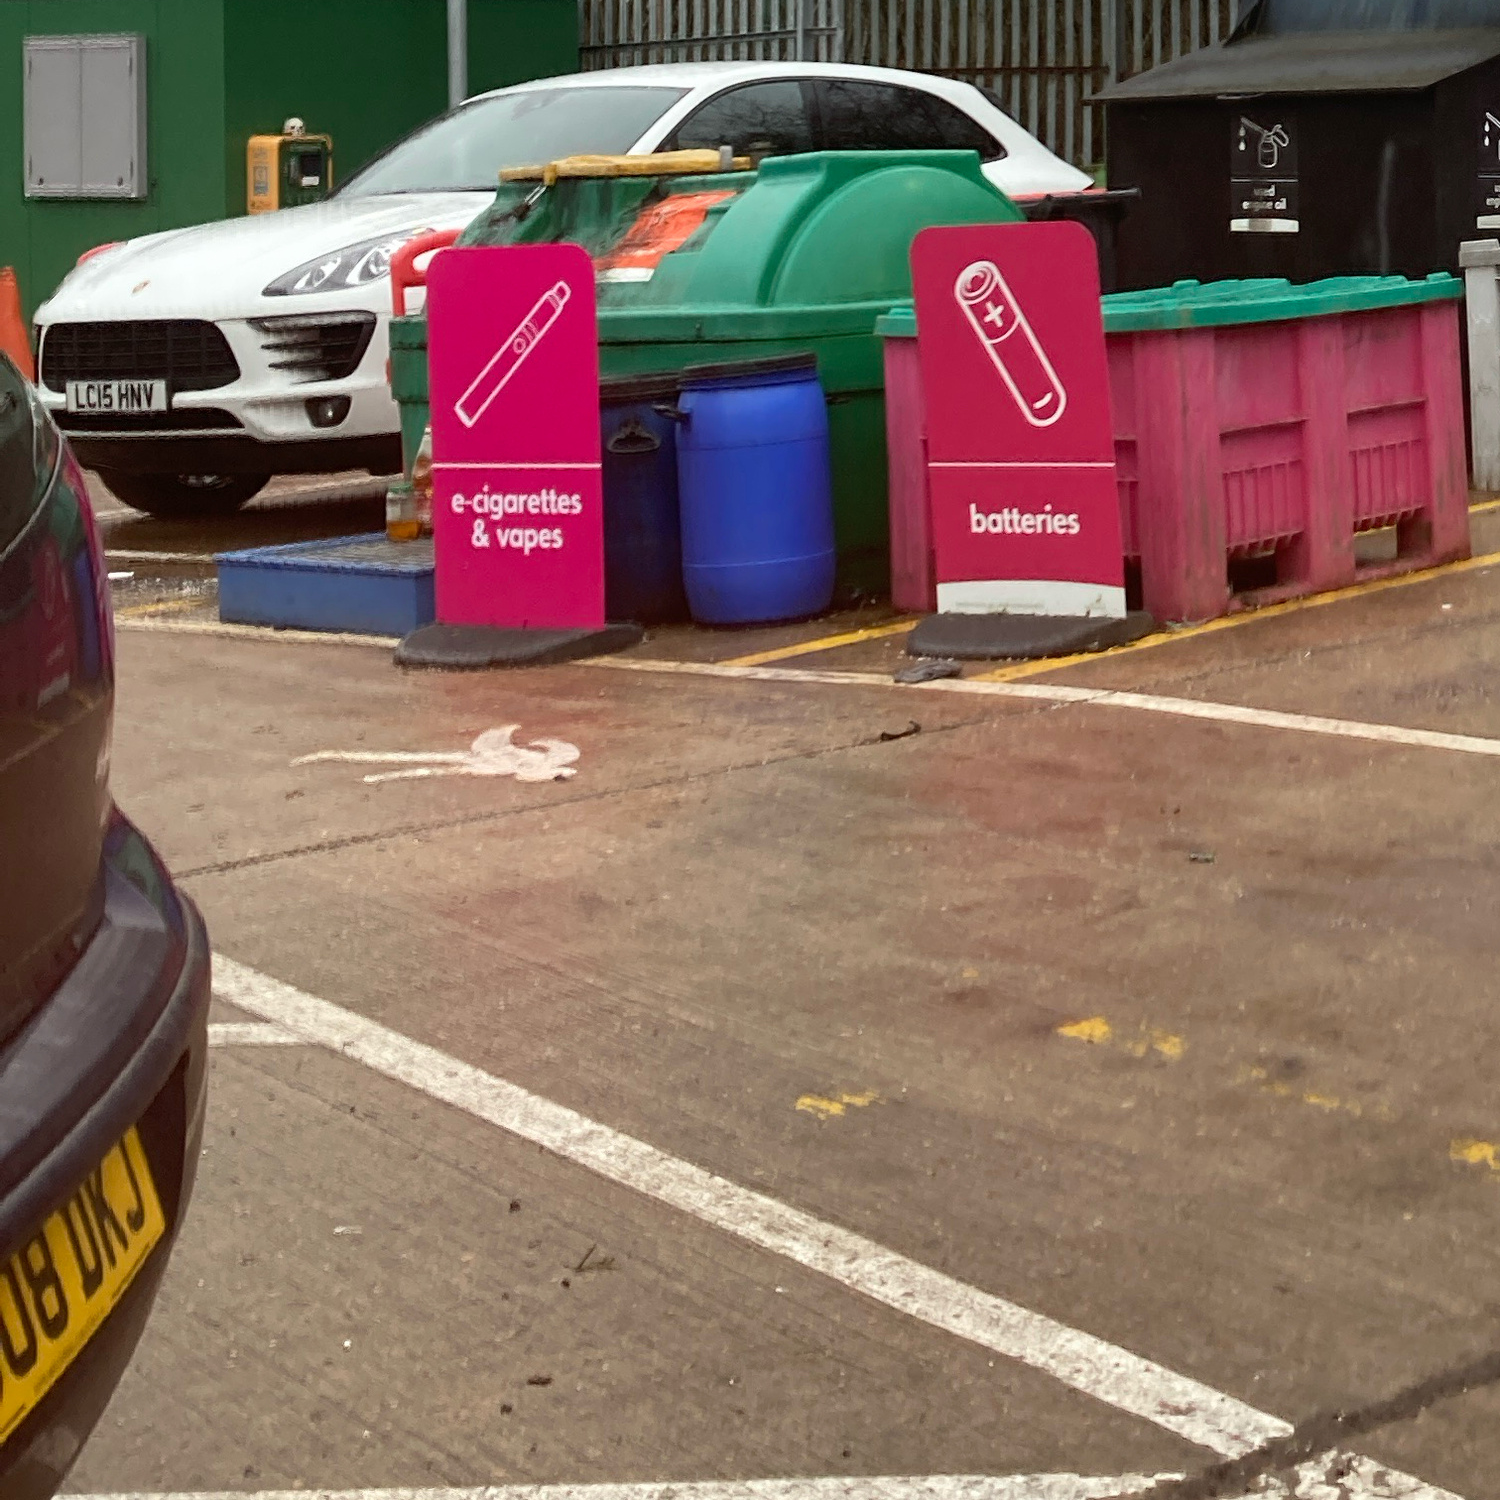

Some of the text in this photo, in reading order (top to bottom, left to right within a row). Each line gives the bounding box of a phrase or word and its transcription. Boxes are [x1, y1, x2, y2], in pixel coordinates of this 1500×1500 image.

[75, 383, 154, 409] LC15 HNV
[451, 484, 583, 521] e-cigarettes
[969, 502, 1081, 535] batteries
[471, 518, 564, 556] & vapes
[0, 1232, 69, 1378] 08
